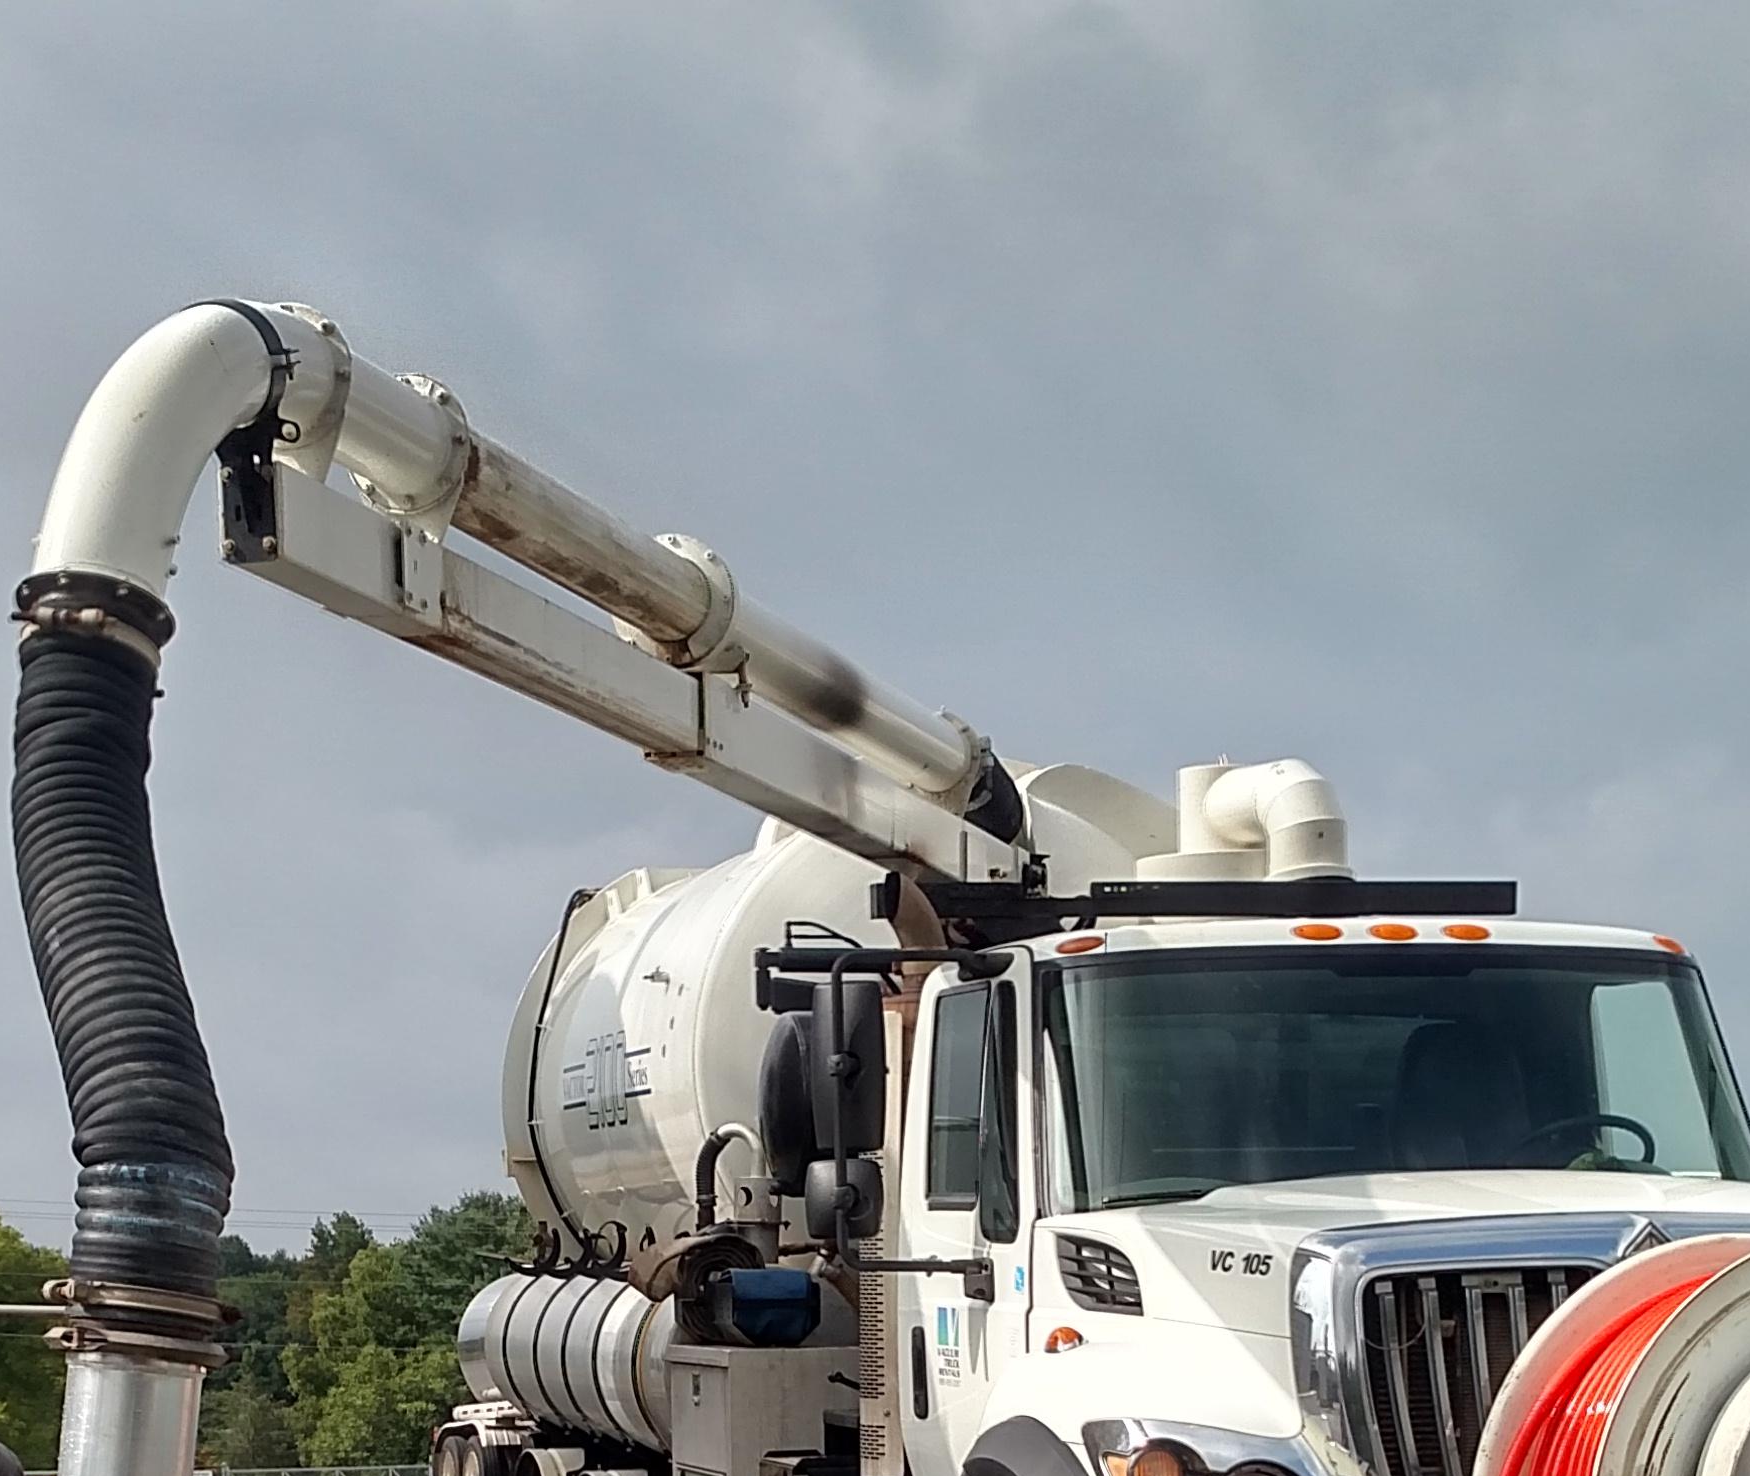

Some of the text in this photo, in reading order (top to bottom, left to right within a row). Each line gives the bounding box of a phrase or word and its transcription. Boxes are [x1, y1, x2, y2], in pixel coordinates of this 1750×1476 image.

[586, 1030, 628, 1130] 2100
[627, 1059, 648, 1089] Series
[1211, 1250, 1273, 1276] VC 105
